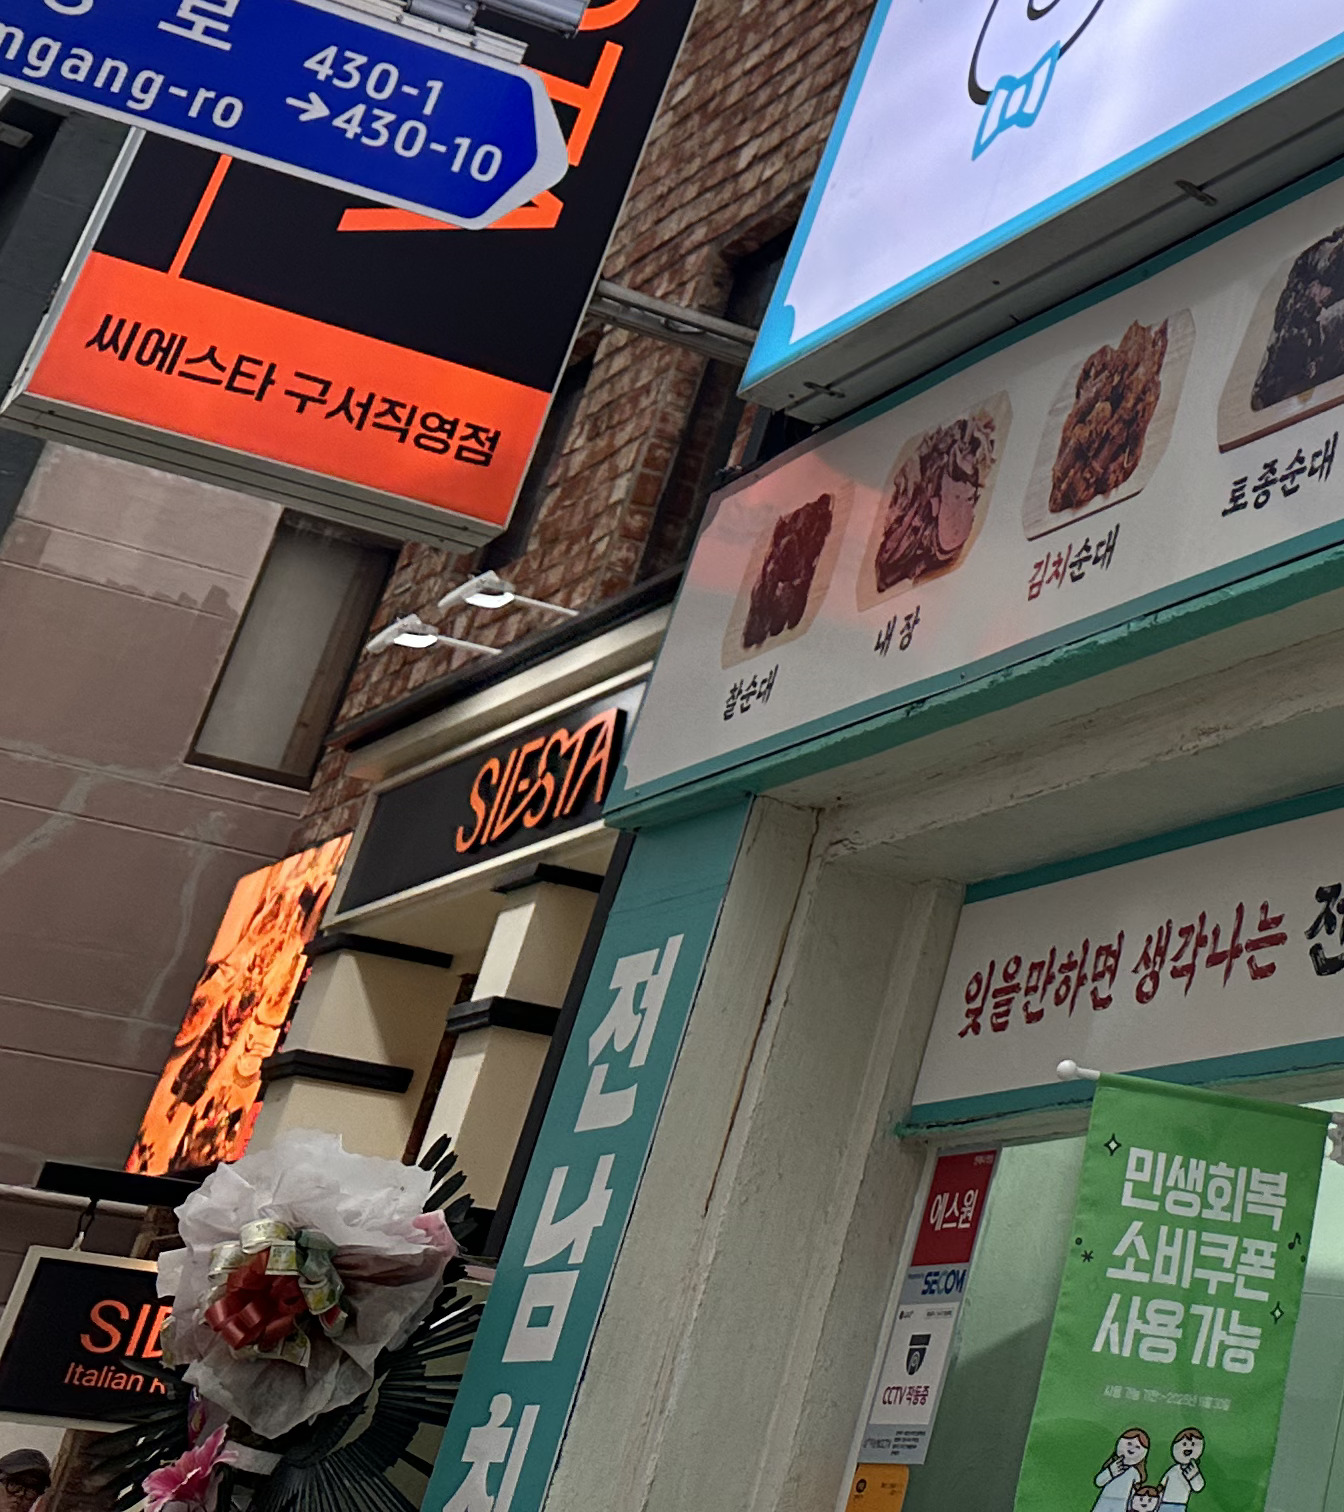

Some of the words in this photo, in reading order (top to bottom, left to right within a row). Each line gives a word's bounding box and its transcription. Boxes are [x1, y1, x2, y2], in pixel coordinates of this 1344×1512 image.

[303, 44, 444, 116] 430-1
[332, 102, 503, 182] 430-10
[85, 314, 275, 402] 씨에스타
[286, 371, 502, 469] 구서직영점
[1221, 430, 1340, 519] 토종순대
[1026, 523, 1121, 601] 김치순대
[722, 664, 779, 722] 찰순대
[456, 707, 619, 853] SIESTA
[958, 930, 1125, 1038] 잊을만하면
[1131, 900, 1288, 1005] 생각나는
[929, 1189, 979, 1231] 에스원
[1121, 1146, 1288, 1232] 민생회복
[921, 1269, 966, 1296] SECOM
[1105, 1220, 1278, 1302] 소비쿠폰
[80, 1299, 173, 1359] SIE
[1092, 1292, 1185, 1364] 사용
[1190, 1303, 1263, 1374] 가능
[64, 1361, 145, 1392] Italian
